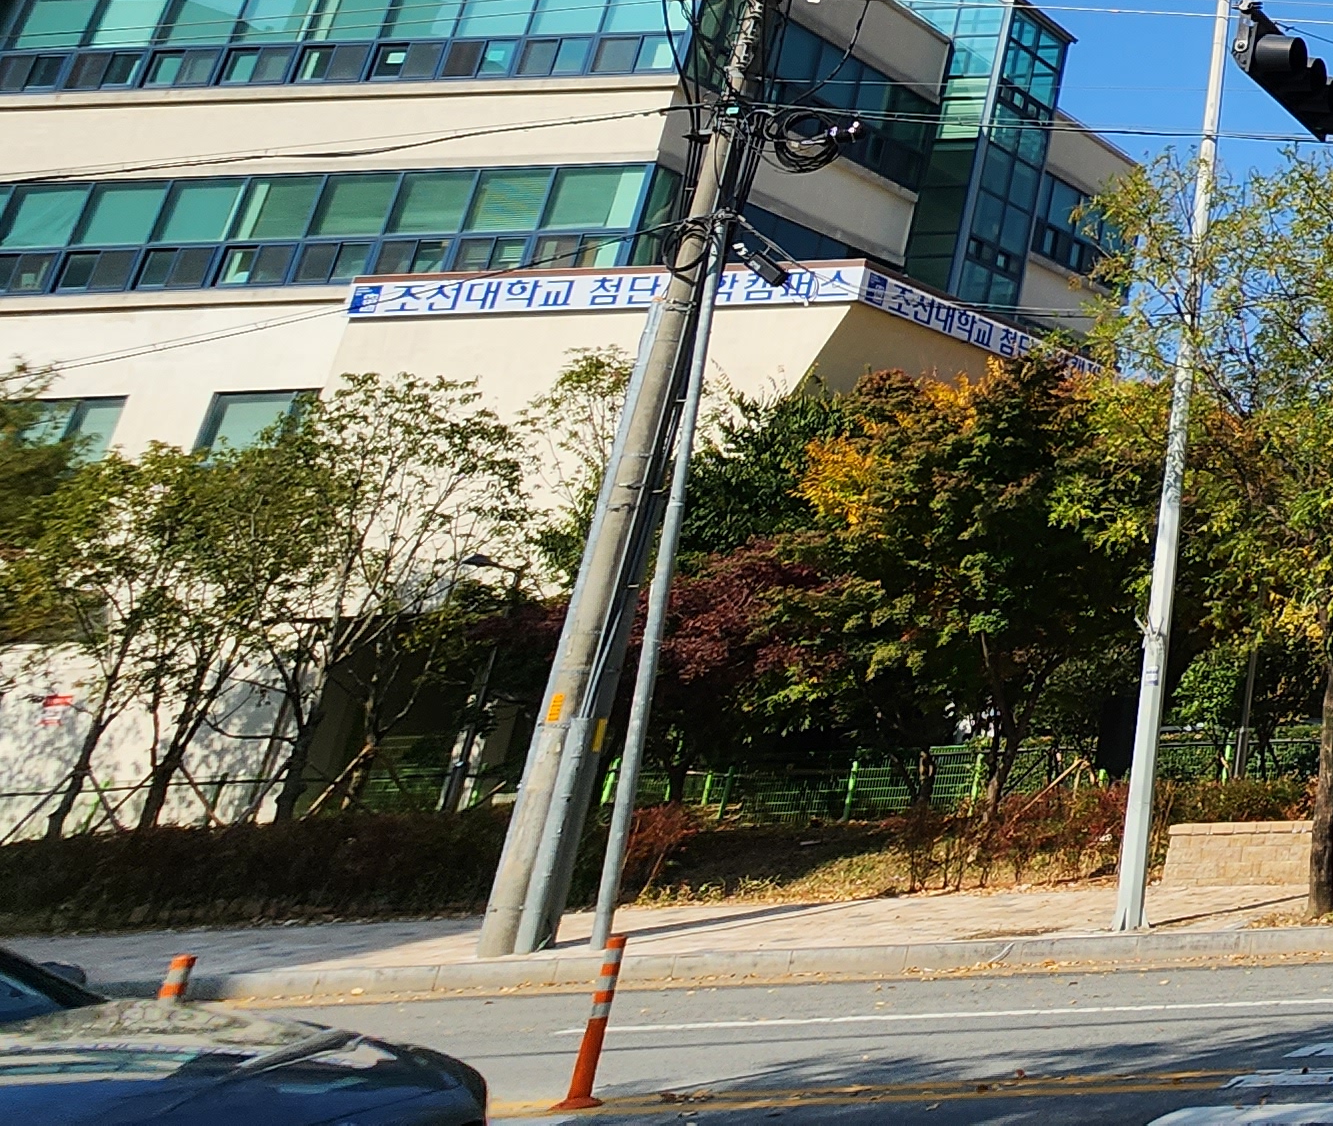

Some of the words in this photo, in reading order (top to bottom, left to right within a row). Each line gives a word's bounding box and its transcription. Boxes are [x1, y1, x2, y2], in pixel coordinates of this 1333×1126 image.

[384, 279, 576, 313] 조선대학교
[589, 275, 662, 306] 첨단
[887, 283, 995, 349] 조선대학교
